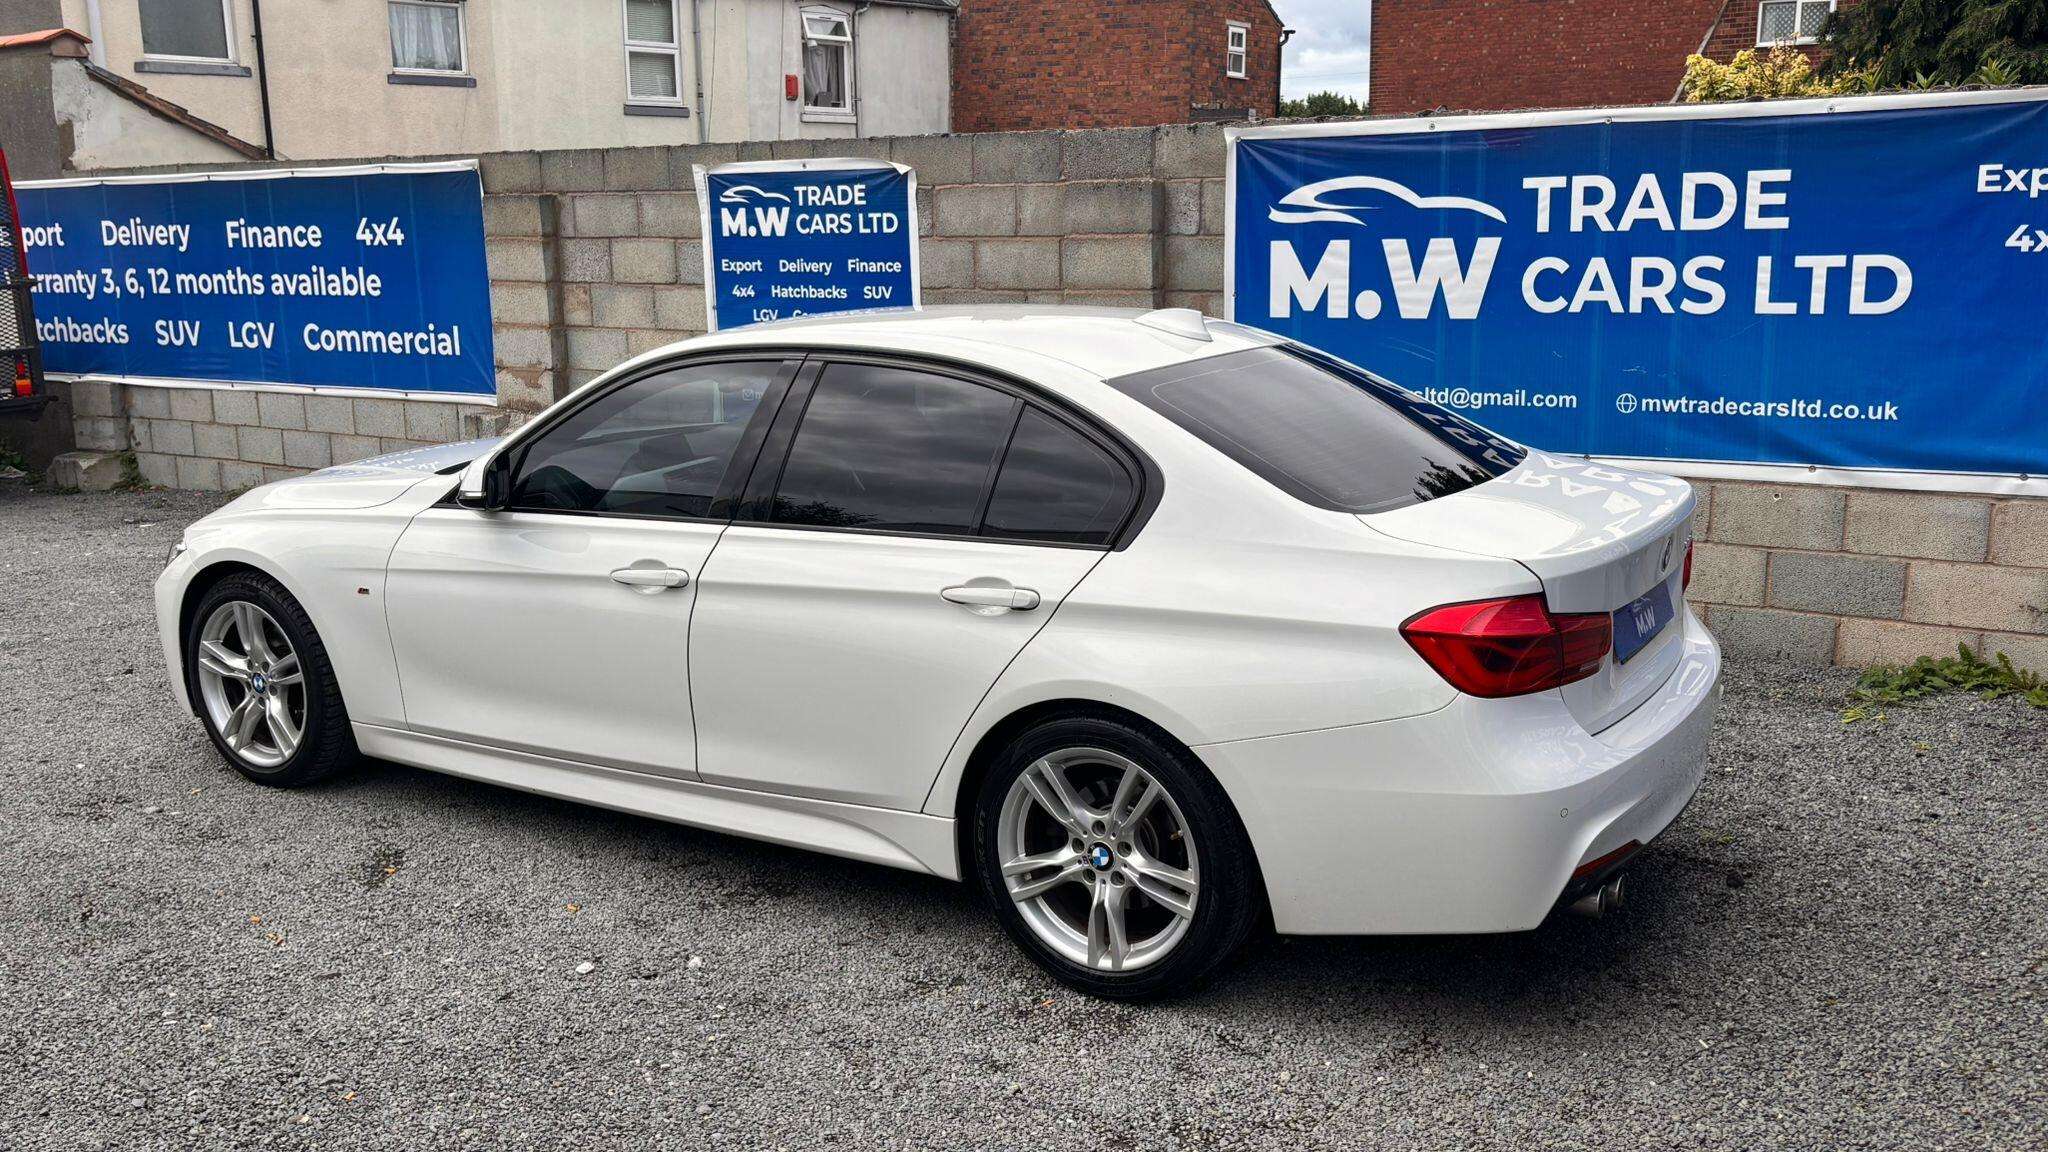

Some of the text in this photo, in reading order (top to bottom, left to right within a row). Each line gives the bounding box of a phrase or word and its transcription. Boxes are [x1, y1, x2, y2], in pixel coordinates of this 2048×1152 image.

[794, 184, 866, 206] TRADE
[1977, 164, 2048, 198] Exp
[1522, 169, 1792, 232] TRADE
[101, 217, 190, 252] Delivery
[226, 218, 322, 248] Finance
[355, 217, 405, 246] 4x4
[720, 206, 790, 237] M.W
[795, 212, 899, 235] CARS LTD
[101, 268, 121, 299] 3,
[125, 268, 145, 299] 6,
[147, 268, 171, 294] 12
[176, 267, 264, 295] months
[271, 265, 382, 297] available
[721, 258, 902, 276] Export Delivery Finance
[1270, 237, 1502, 319] M.W
[732, 284, 893, 299] 4x4 Hatchbacks SUV
[1521, 254, 1913, 315] CARS LTD
[753, 309, 779, 322] LGV
[155, 319, 200, 347] SUV
[228, 321, 275, 349] LGV
[303, 324, 461, 356] Commercial
[1641, 396, 1898, 420] mwtradecarsltd.co.uk
